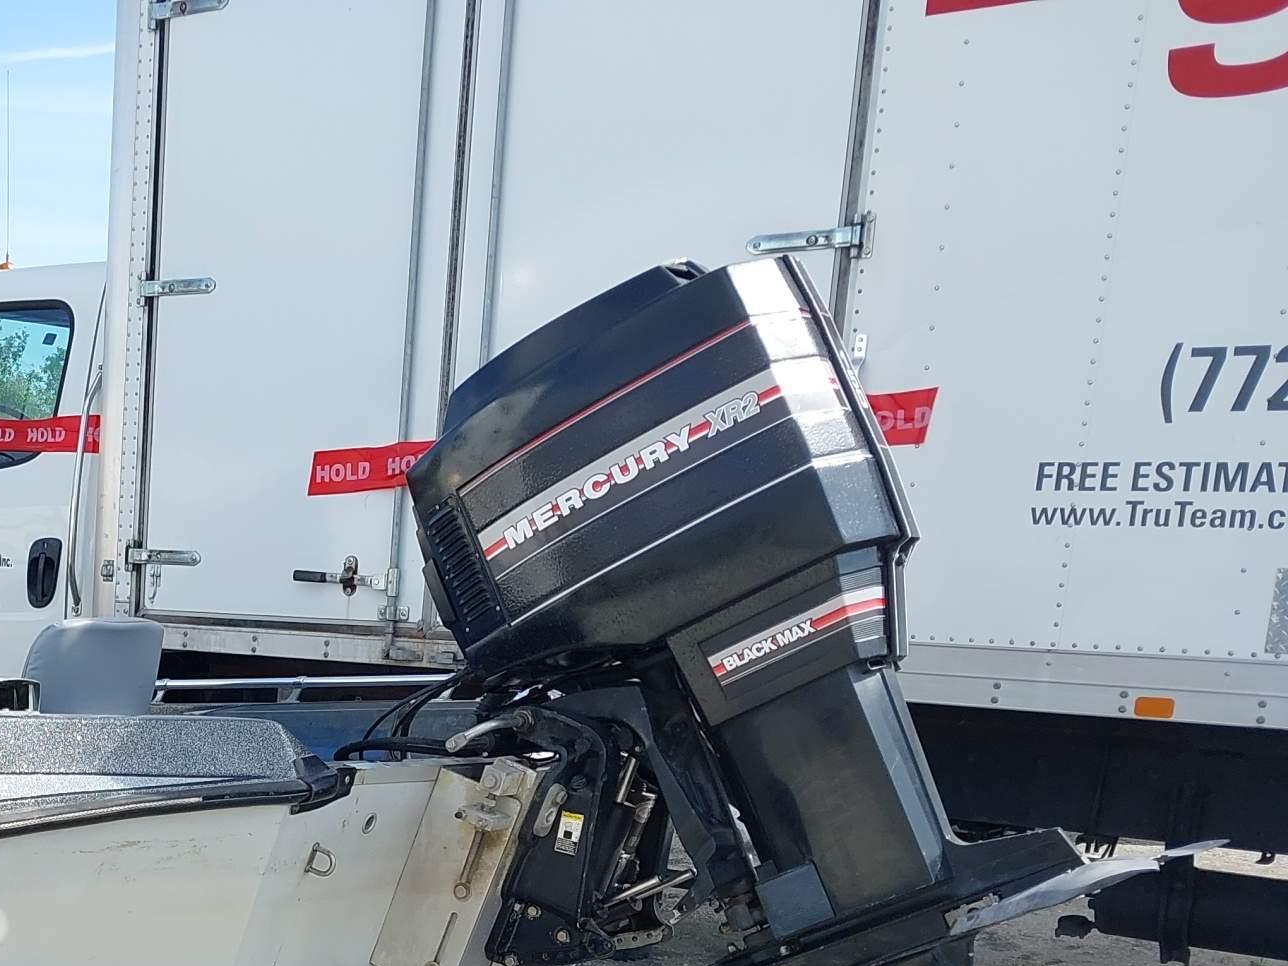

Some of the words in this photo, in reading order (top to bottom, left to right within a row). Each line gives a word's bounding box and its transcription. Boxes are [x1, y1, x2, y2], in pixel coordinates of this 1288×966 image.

[26, 427, 66, 442] HOLD
[315, 461, 370, 483] HOLD
[387, 455, 423, 476] HO
[503, 424, 693, 549] MERCURY
[703, 391, 762, 439] XR2
[1035, 461, 1121, 492] FREE
[1031, 500, 1286, 530] www.TruTeam.c
[0, 554, 13, 568] Inc.
[721, 639, 779, 671] BLACK
[777, 618, 816, 647] MAX
